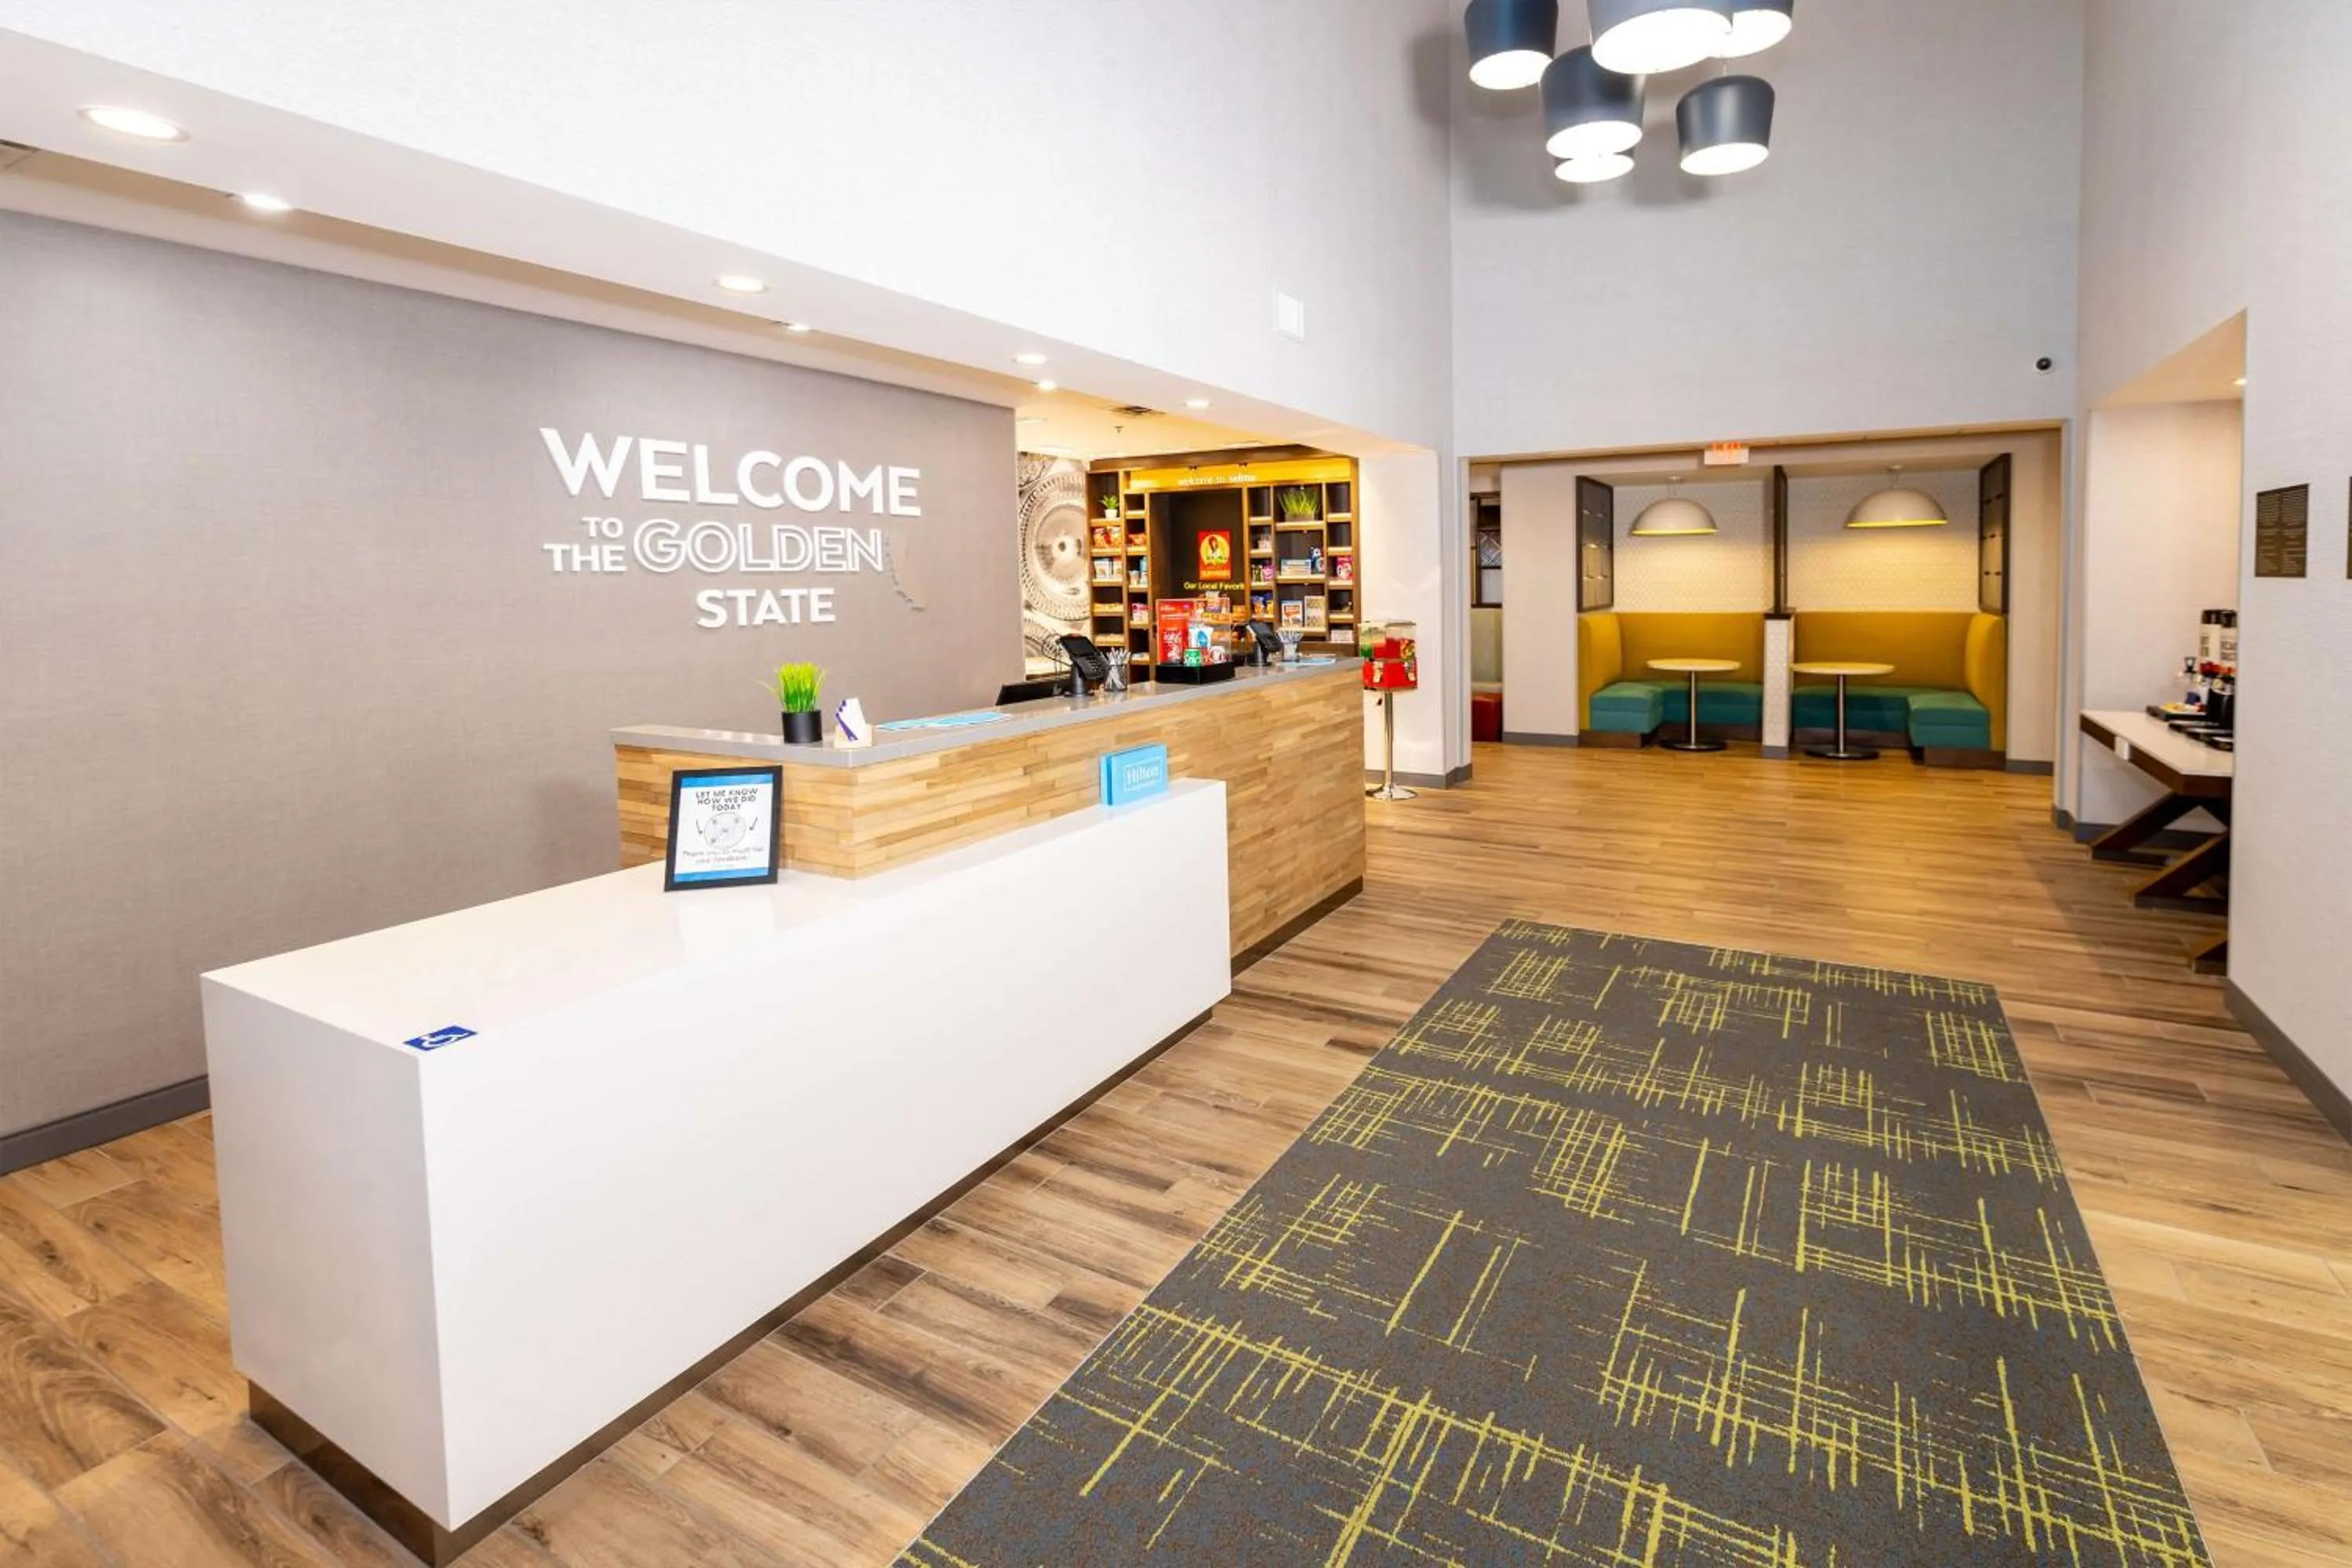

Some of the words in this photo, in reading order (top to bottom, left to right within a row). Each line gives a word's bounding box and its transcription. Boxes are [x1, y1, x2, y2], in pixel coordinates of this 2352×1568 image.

[539, 427, 921, 517] WELCOME
[581, 516, 624, 539] TO
[543, 543, 627, 572] THE
[633, 518, 884, 574] GOLDEN
[1183, 581, 1197, 590] Our
[1198, 582, 1218, 590] Local
[695, 587, 837, 628] STATE
[695, 790, 710, 799] LET
